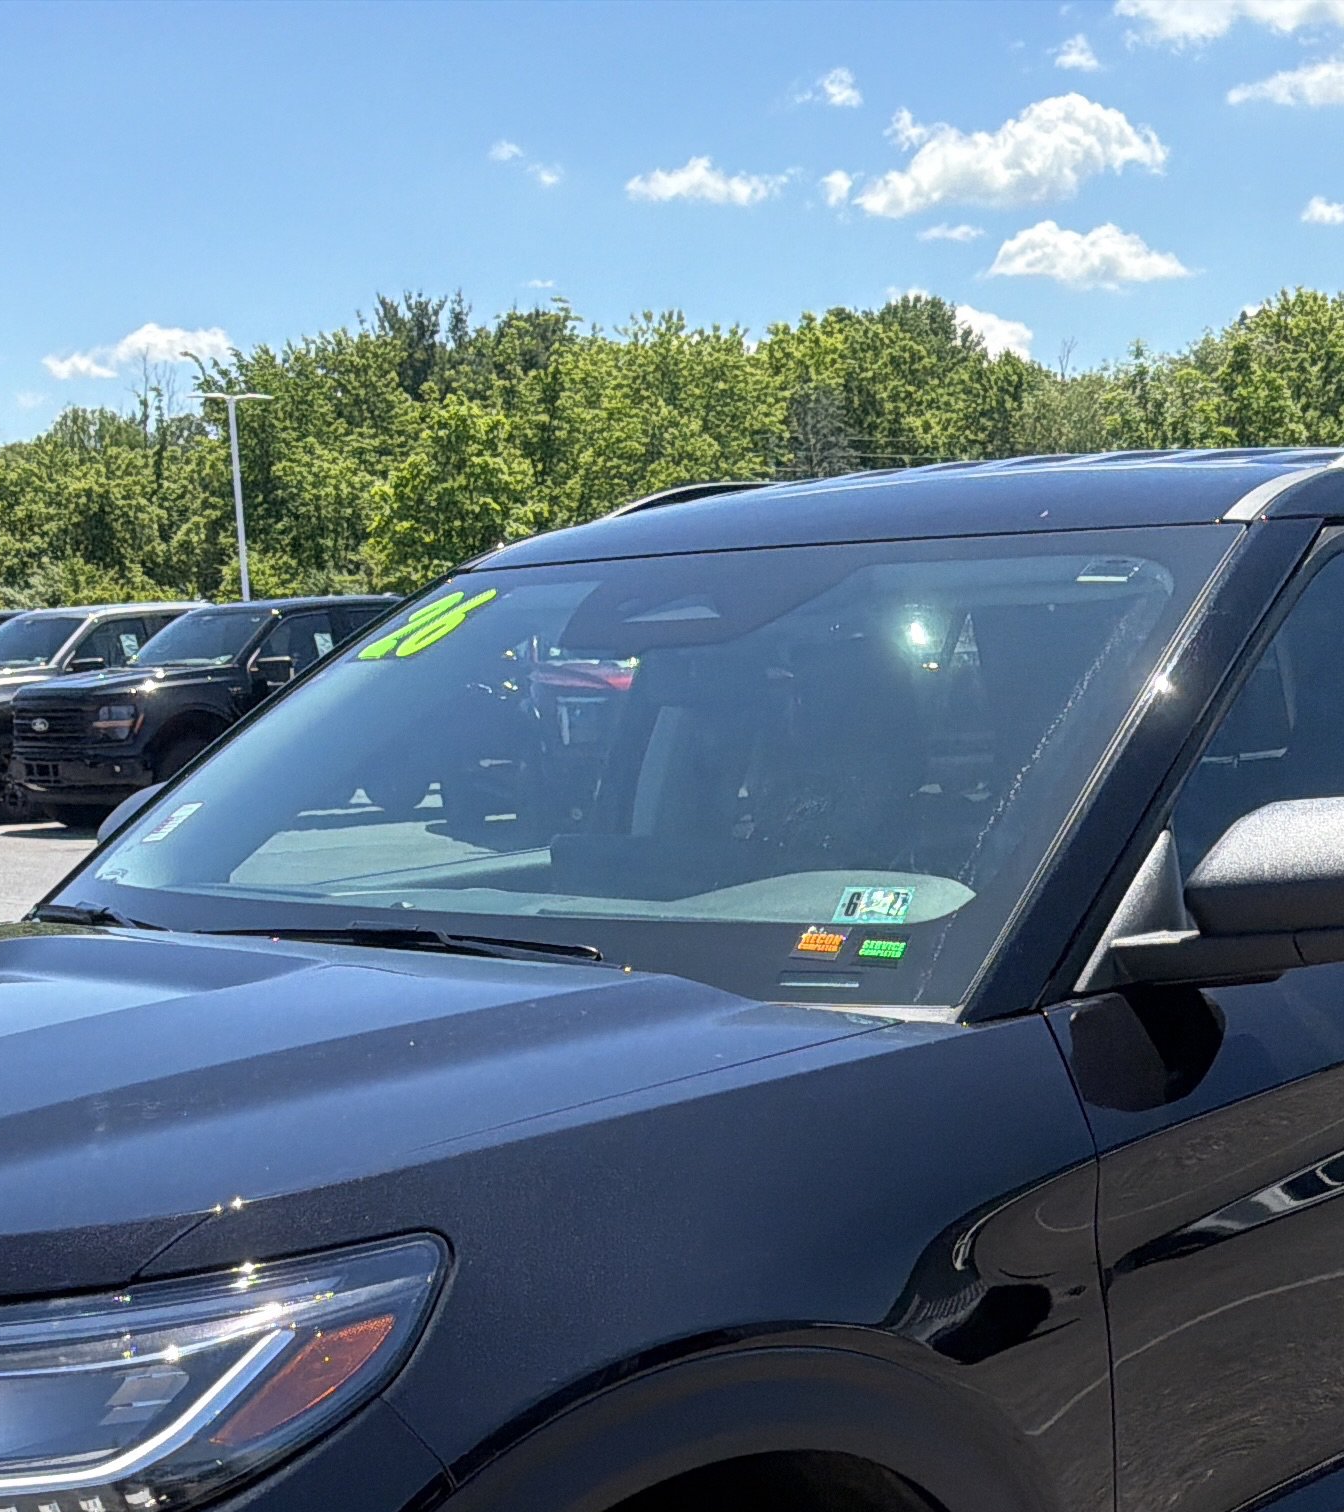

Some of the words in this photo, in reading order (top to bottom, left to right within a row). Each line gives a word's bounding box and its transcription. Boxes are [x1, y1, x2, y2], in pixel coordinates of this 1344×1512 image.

[358, 588, 497, 660] 26
[844, 891, 862, 917] 6
[801, 933, 844, 945] RECON
[862, 940, 907, 951] SERVICE
